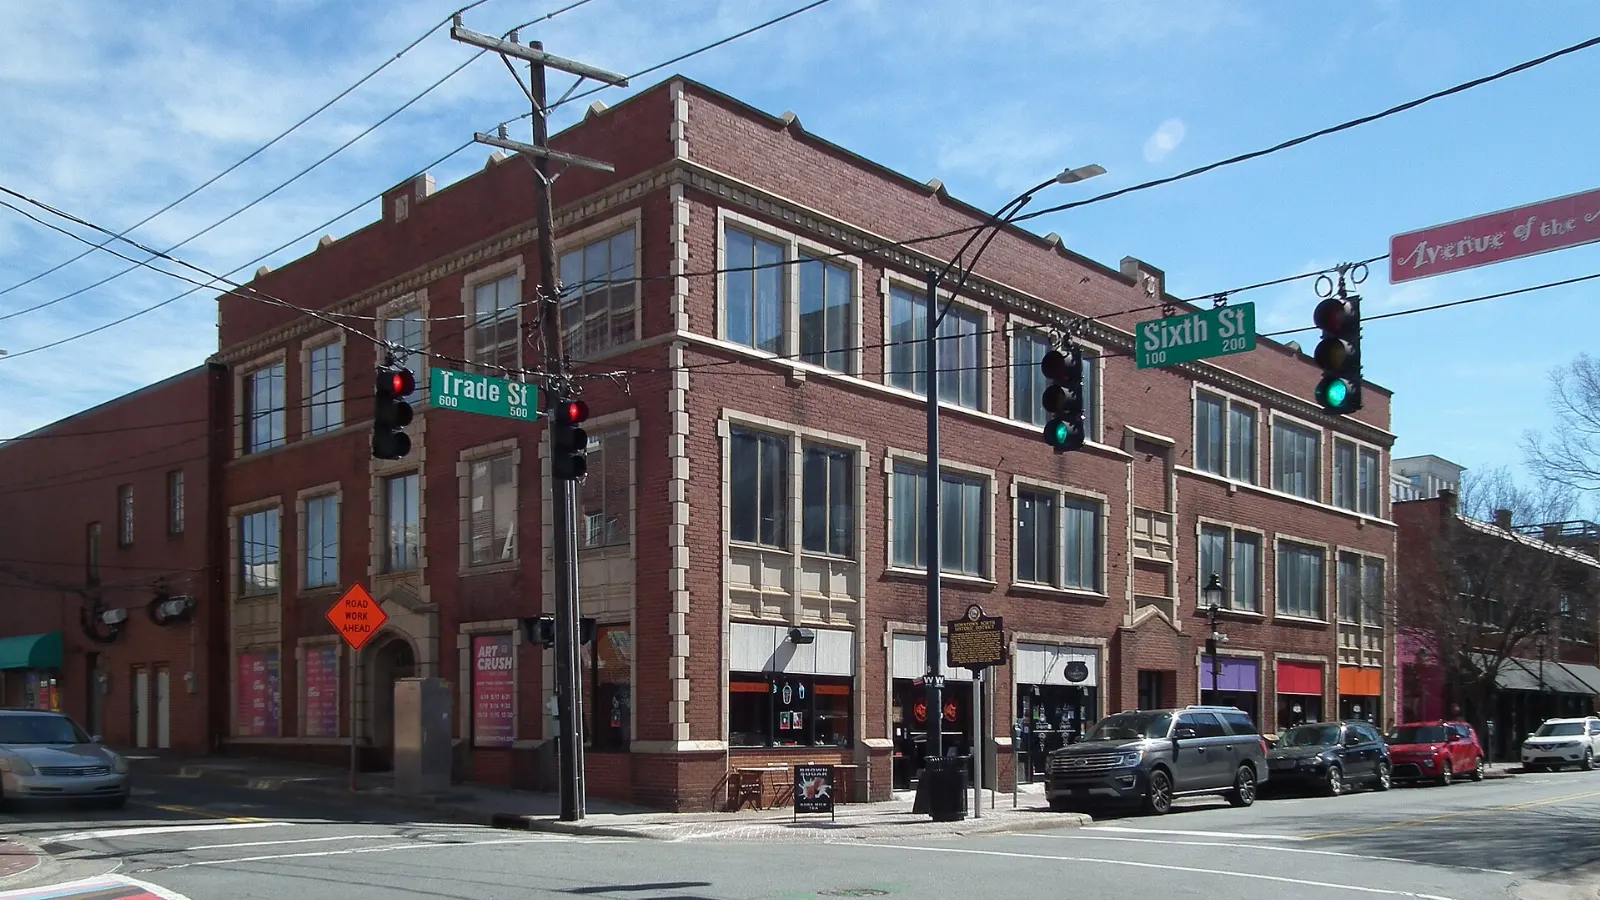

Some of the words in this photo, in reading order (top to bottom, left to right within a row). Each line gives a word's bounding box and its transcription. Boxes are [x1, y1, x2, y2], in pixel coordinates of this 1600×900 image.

[1397, 231, 1506, 268] Avenue
[1513, 215, 1537, 242] of
[1539, 216, 1577, 237] the
[1143, 314, 1208, 351] Sixth
[1217, 308, 1245, 338] St
[1222, 337, 1246, 353] 200
[1144, 350, 1167, 366] 100
[440, 369, 500, 402] Trade
[507, 382, 528, 406] St
[438, 395, 458, 408] 600
[510, 406, 528, 418] 500
[345, 600, 368, 608] ROAD
[345, 612, 368, 620] WORK
[342, 624, 371, 632] AHEAD
[478, 645, 498, 658] ART
[477, 656, 513, 670] CRUSH
